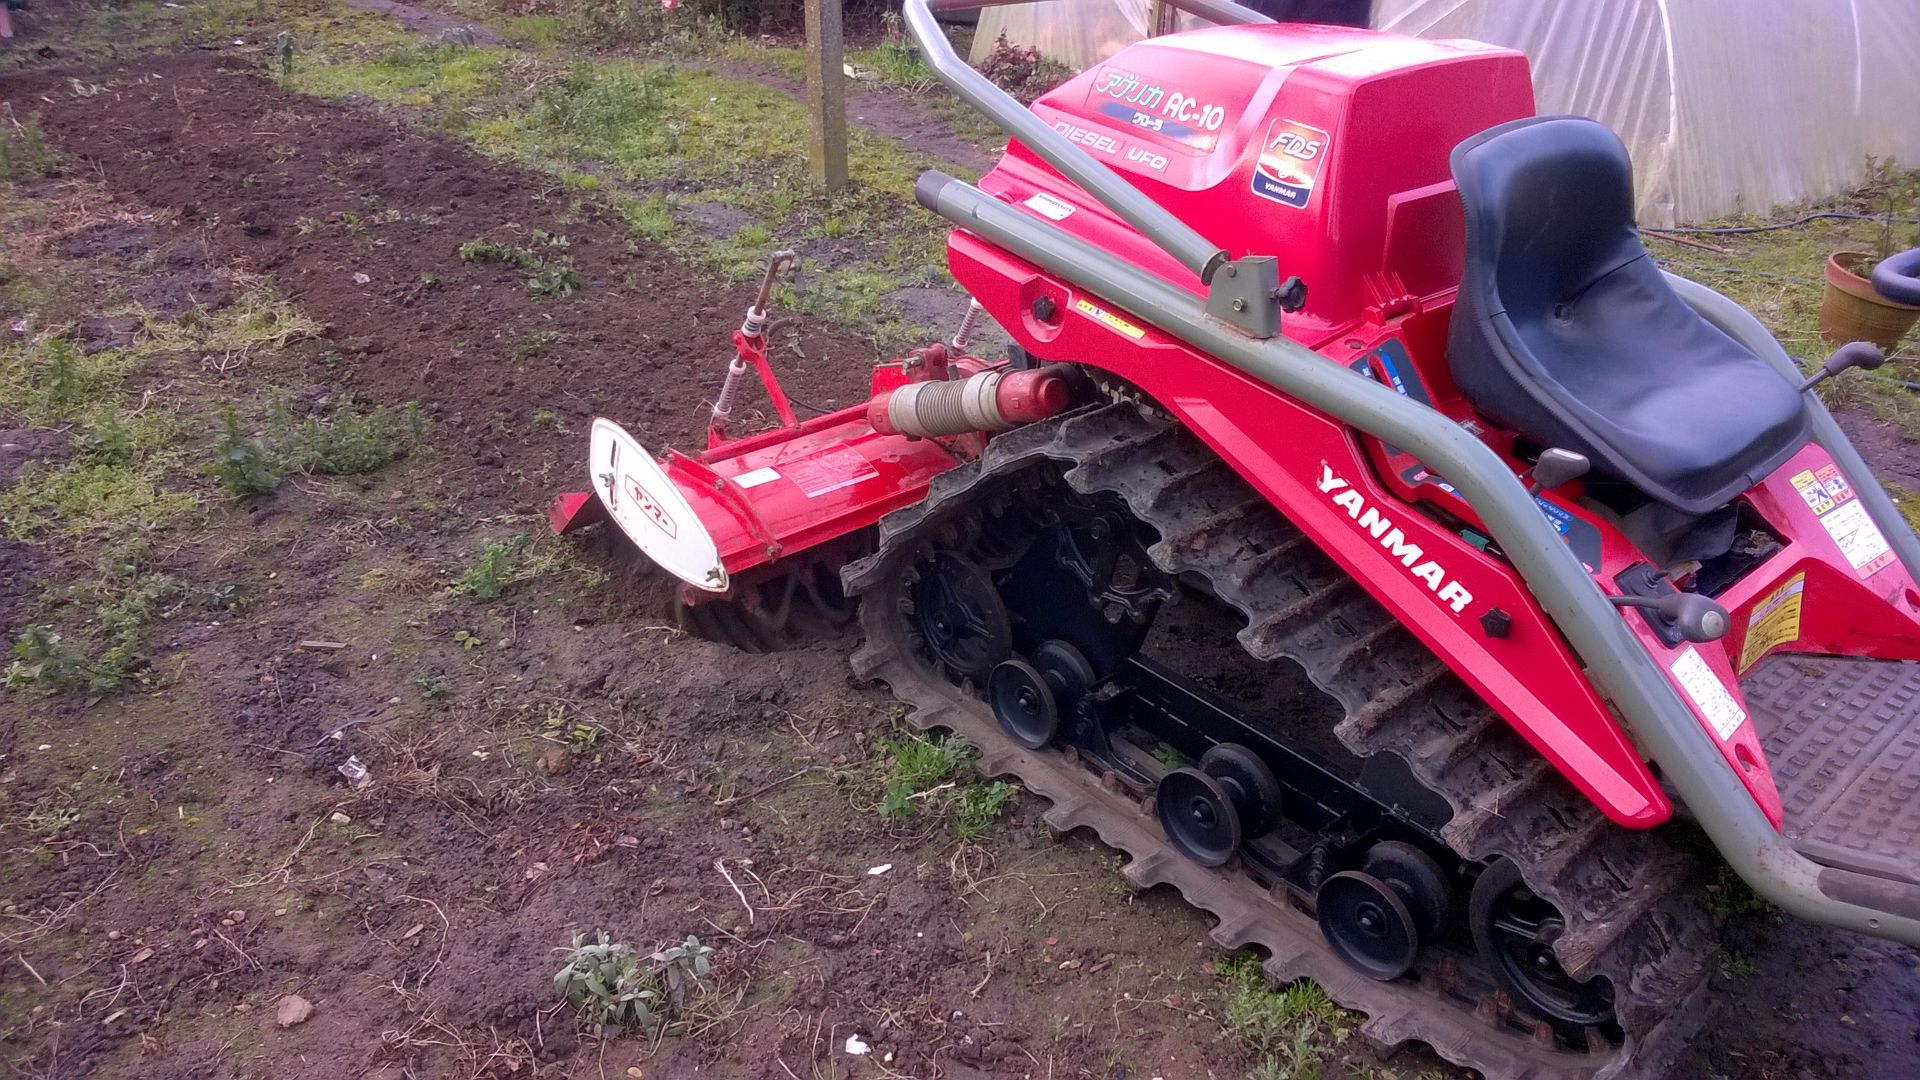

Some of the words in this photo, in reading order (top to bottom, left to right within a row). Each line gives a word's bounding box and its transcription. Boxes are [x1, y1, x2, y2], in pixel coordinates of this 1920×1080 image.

[1162, 92, 1225, 131] AC-10
[1053, 121, 1117, 154] DIESEL
[1127, 147, 1167, 170] UFO
[1269, 132, 1320, 160] FDS
[1264, 182, 1297, 199] YANMAR
[634, 486, 668, 526] ヤンマー
[1318, 464, 1473, 613] YANMAR
